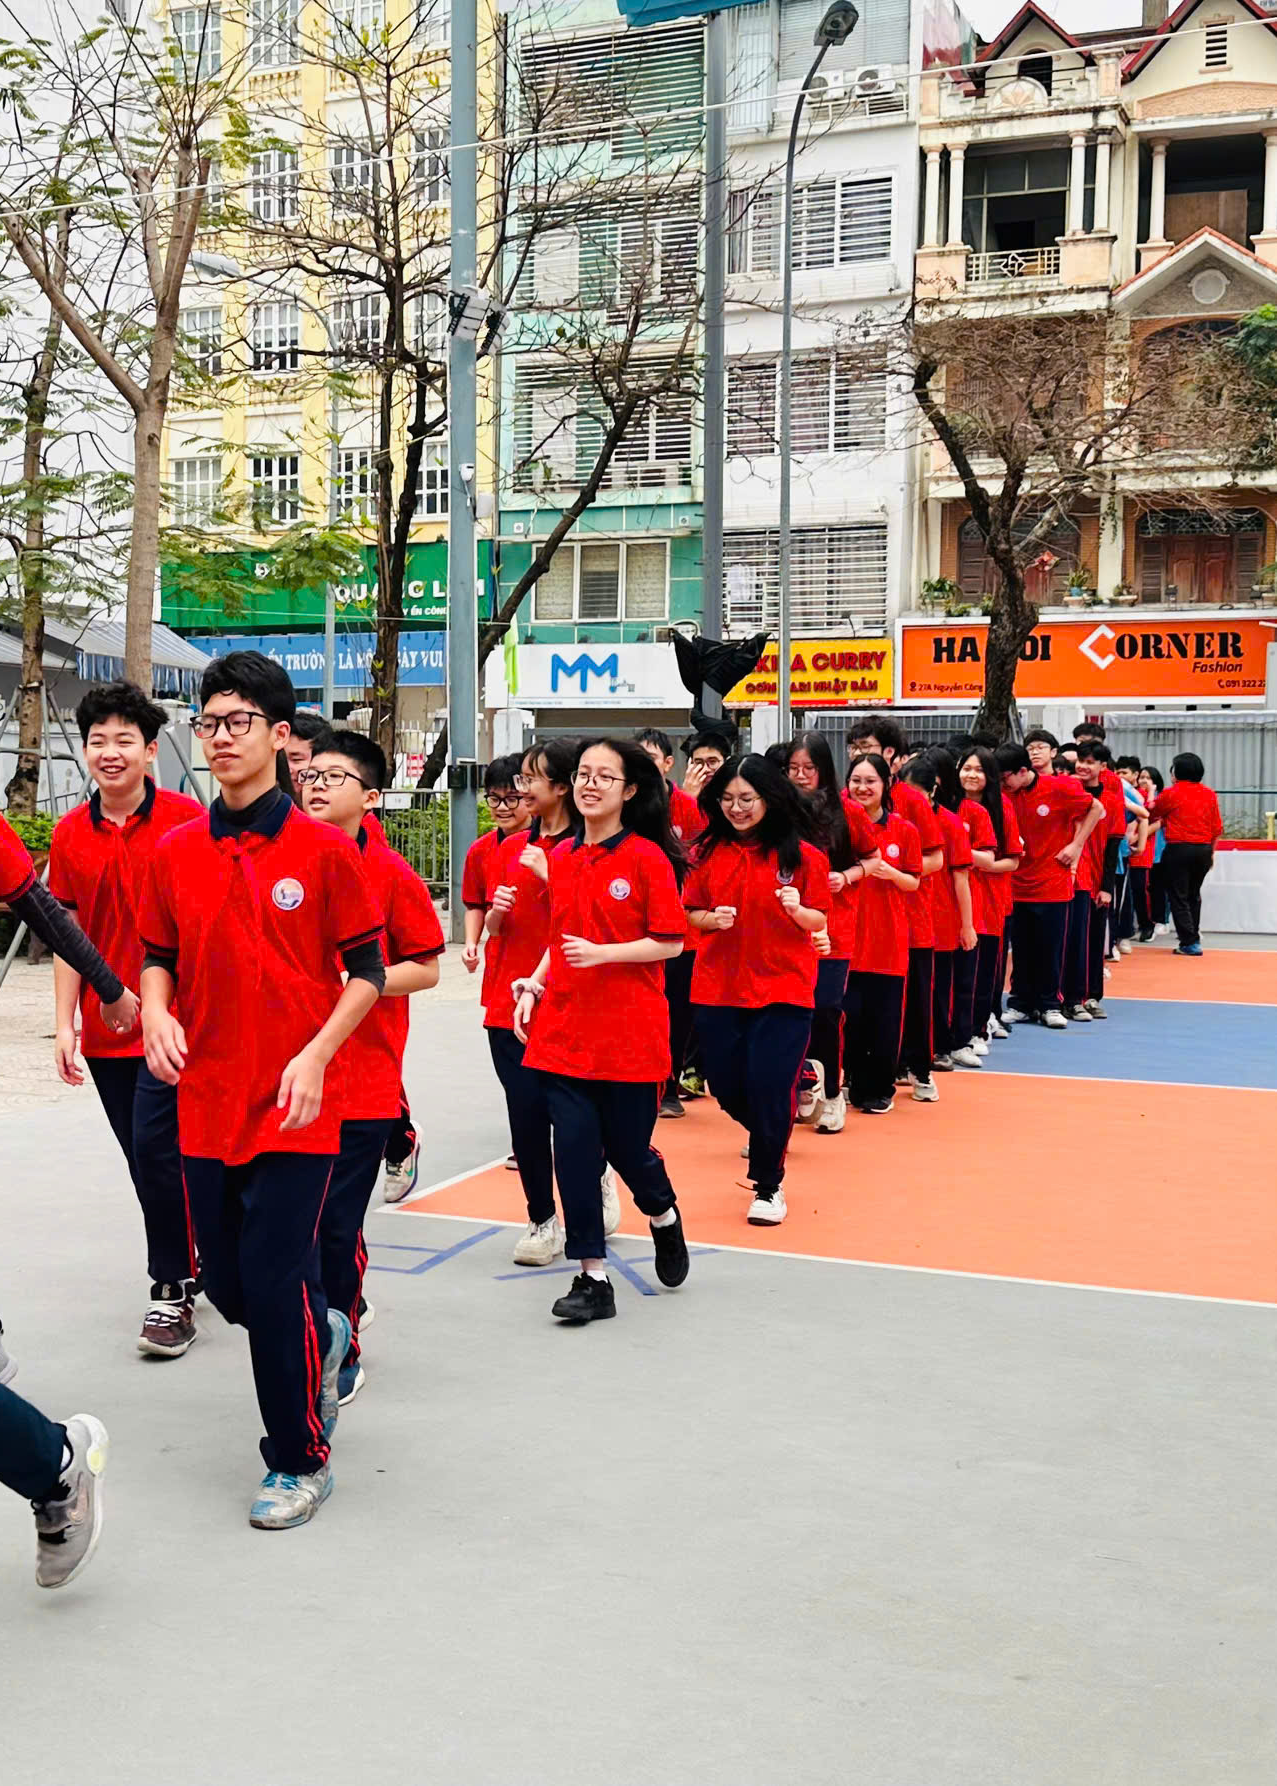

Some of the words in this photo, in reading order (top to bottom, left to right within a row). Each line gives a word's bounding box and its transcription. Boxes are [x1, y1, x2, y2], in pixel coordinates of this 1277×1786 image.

[1078, 624, 1244, 670] CORNER
[338, 648, 355, 670] LÀ
[420, 650, 444, 668] VUI
[811, 651, 887, 673] CURRY
[1192, 661, 1243, 673] Fashion
[1226, 680, 1240, 688] 091
[1242, 680, 1256, 688] 322
